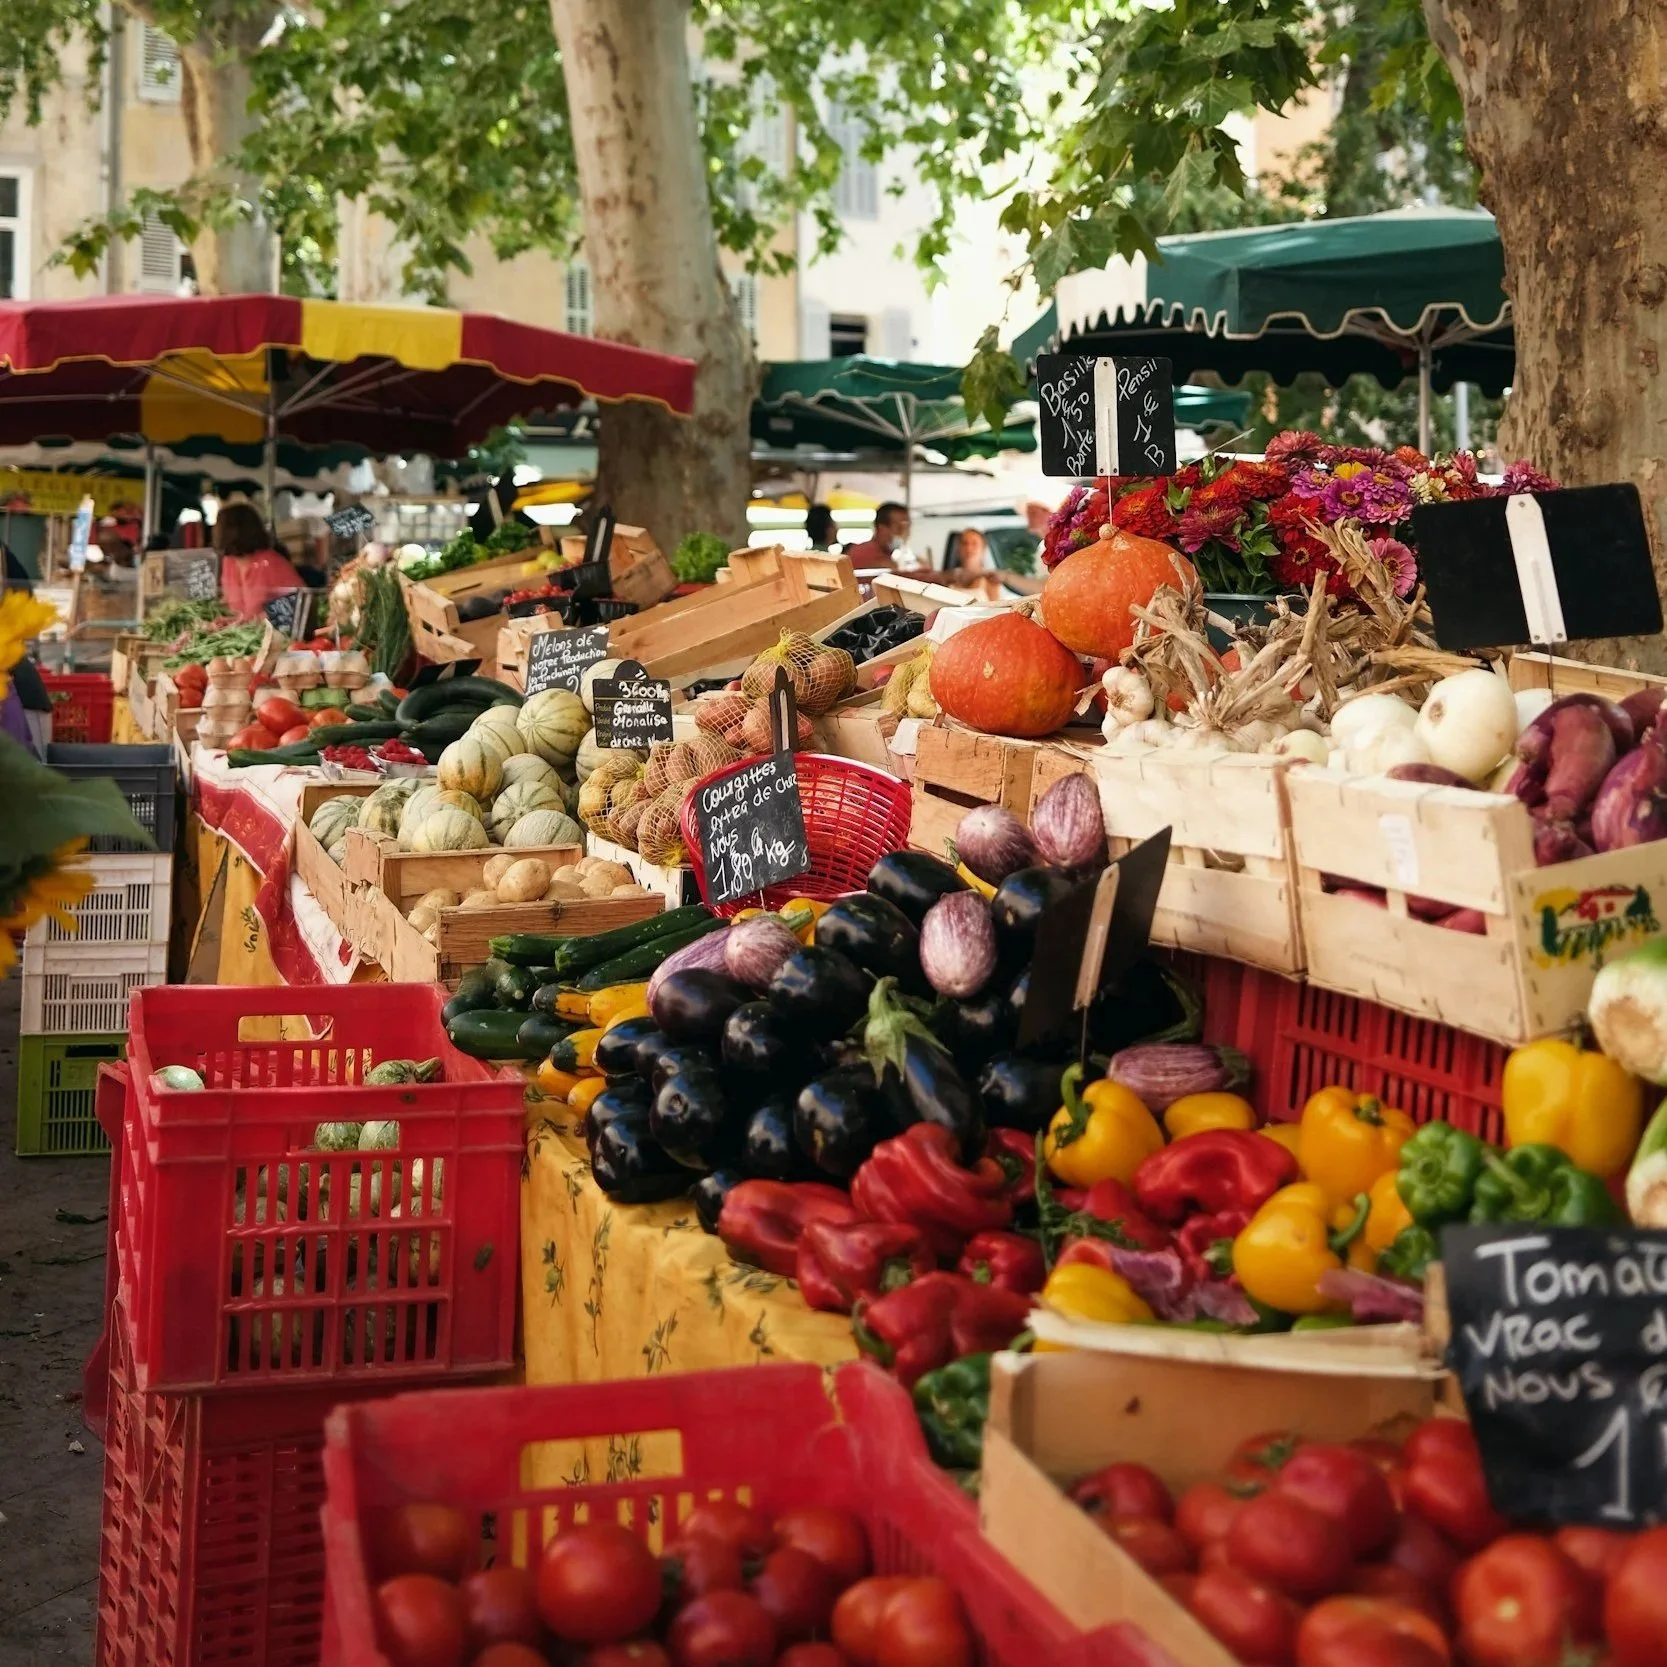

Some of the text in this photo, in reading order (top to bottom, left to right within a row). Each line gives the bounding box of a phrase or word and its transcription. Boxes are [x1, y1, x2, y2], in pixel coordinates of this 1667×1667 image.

[1144, 443, 1165, 468] B
[532, 633, 572, 660] Melons
[702, 761, 776, 813] Courgettes
[1476, 1235, 1667, 1306] Tomat
[1641, 1308, 1667, 1354] d
